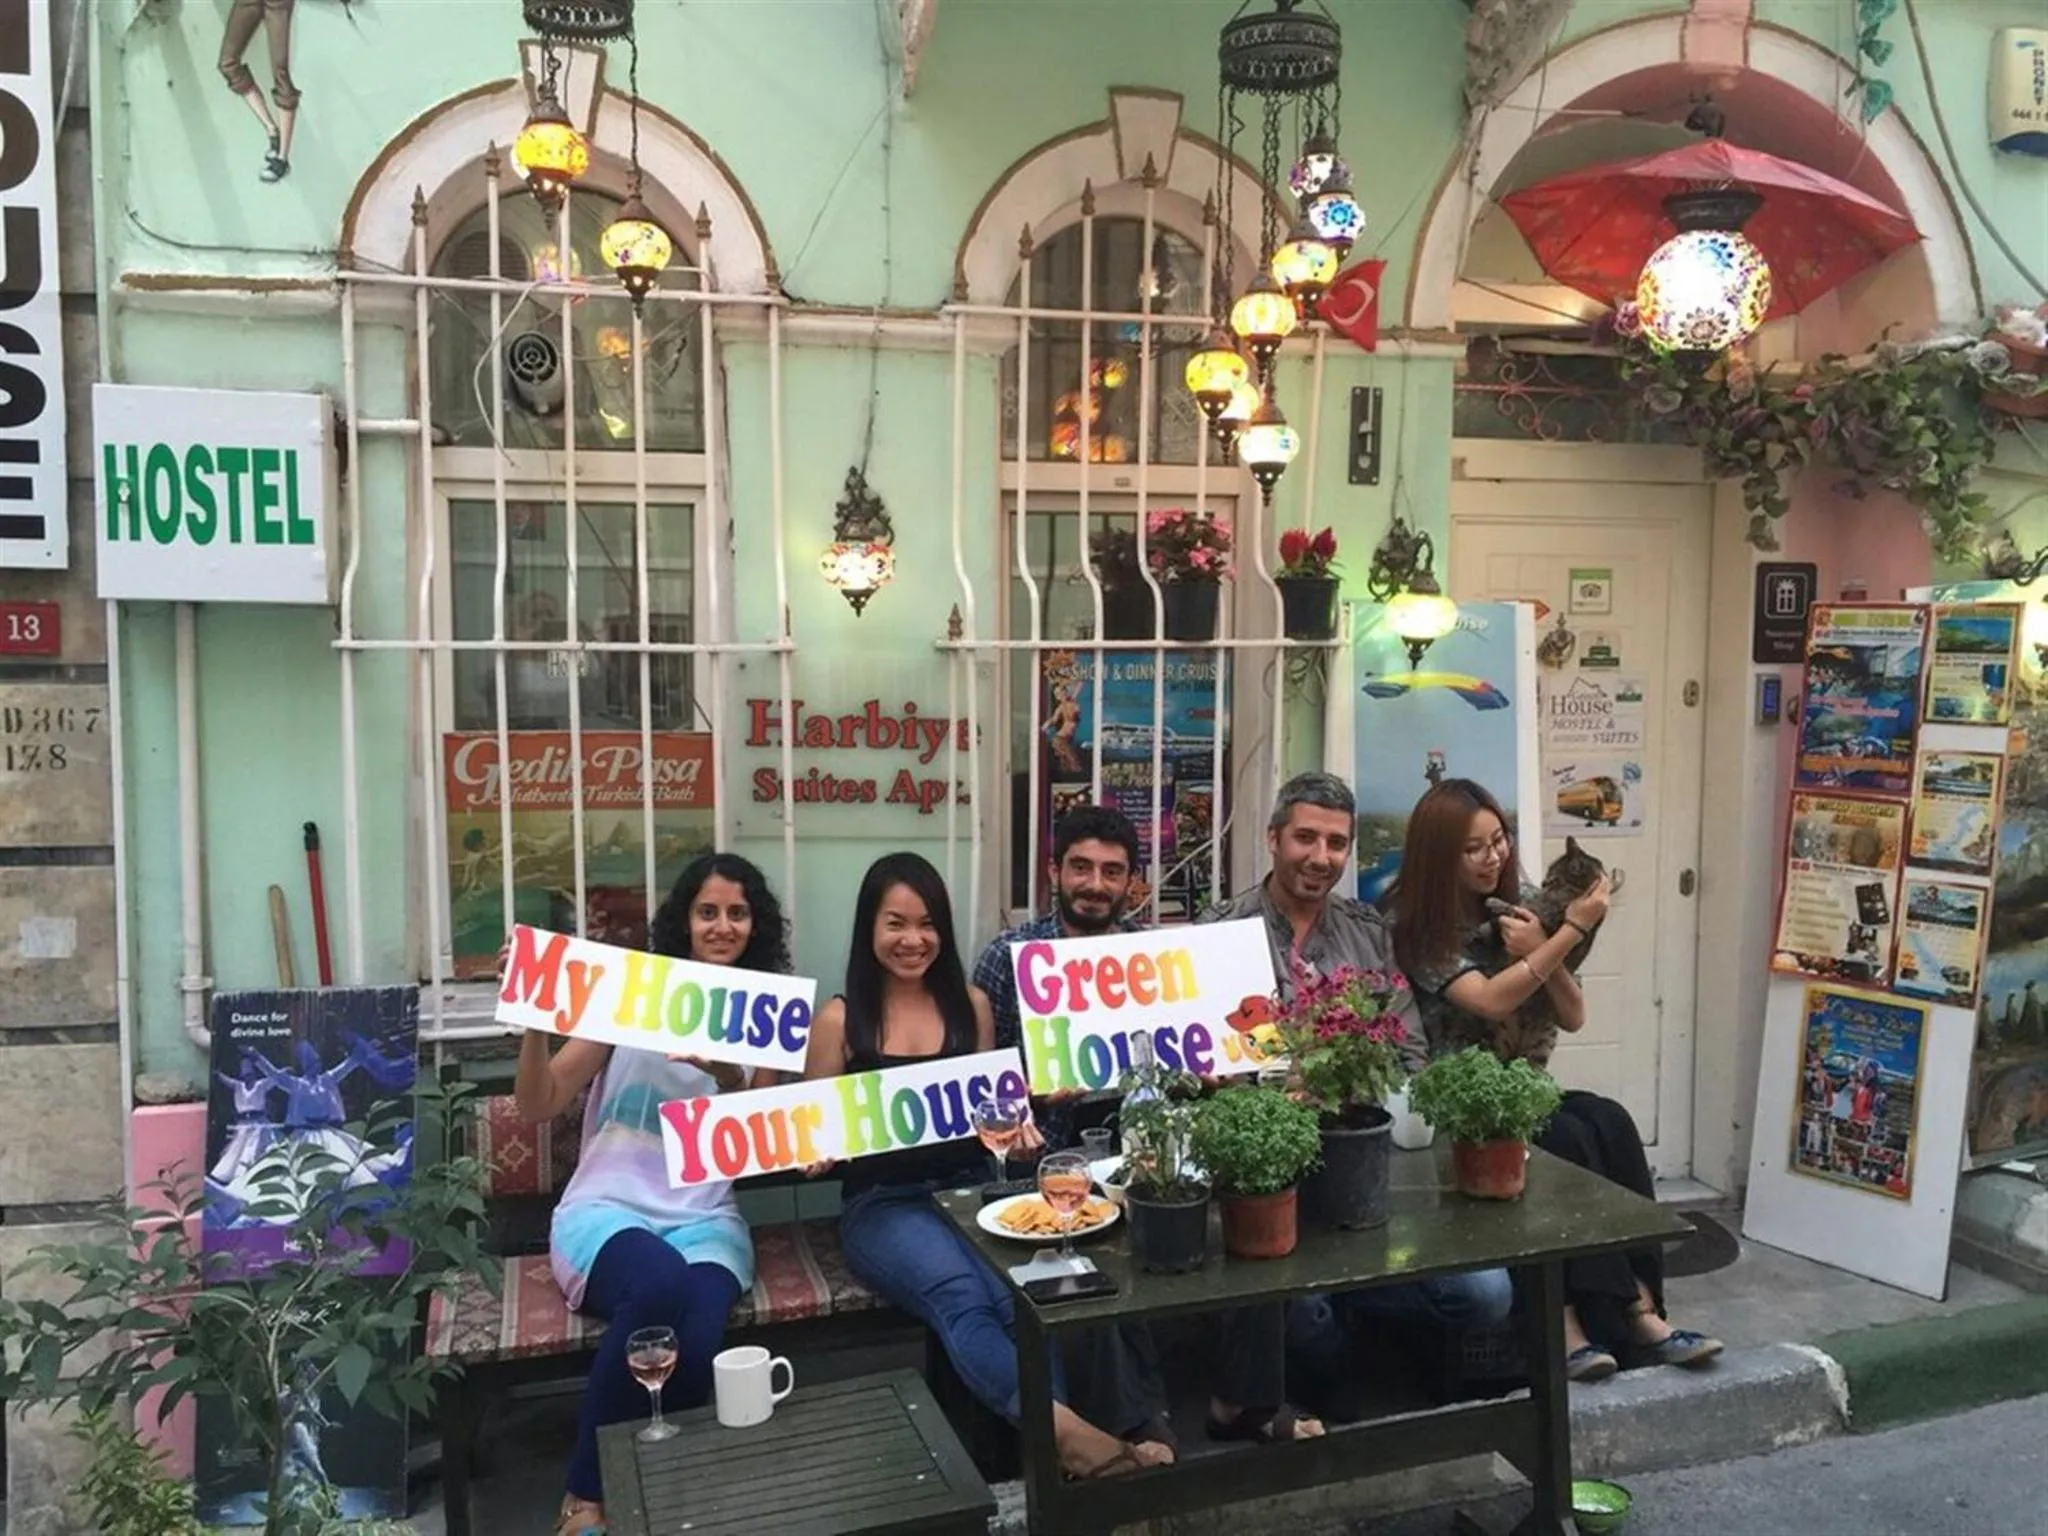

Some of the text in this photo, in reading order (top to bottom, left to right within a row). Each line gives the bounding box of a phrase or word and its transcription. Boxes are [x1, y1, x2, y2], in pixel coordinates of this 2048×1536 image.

[103, 442, 316, 546] HOSTEL
[8, 614, 41, 641] 13
[1551, 694, 1613, 715] House
[453, 738, 588, 805] Gedi
[753, 767, 876, 803] Suites
[500, 923, 811, 1053] My House
[1016, 939, 1200, 1015] Green
[230, 1026, 293, 1038] divine love
[231, 1010, 289, 1024] Dance for
[662, 1067, 1029, 1184] Your House
